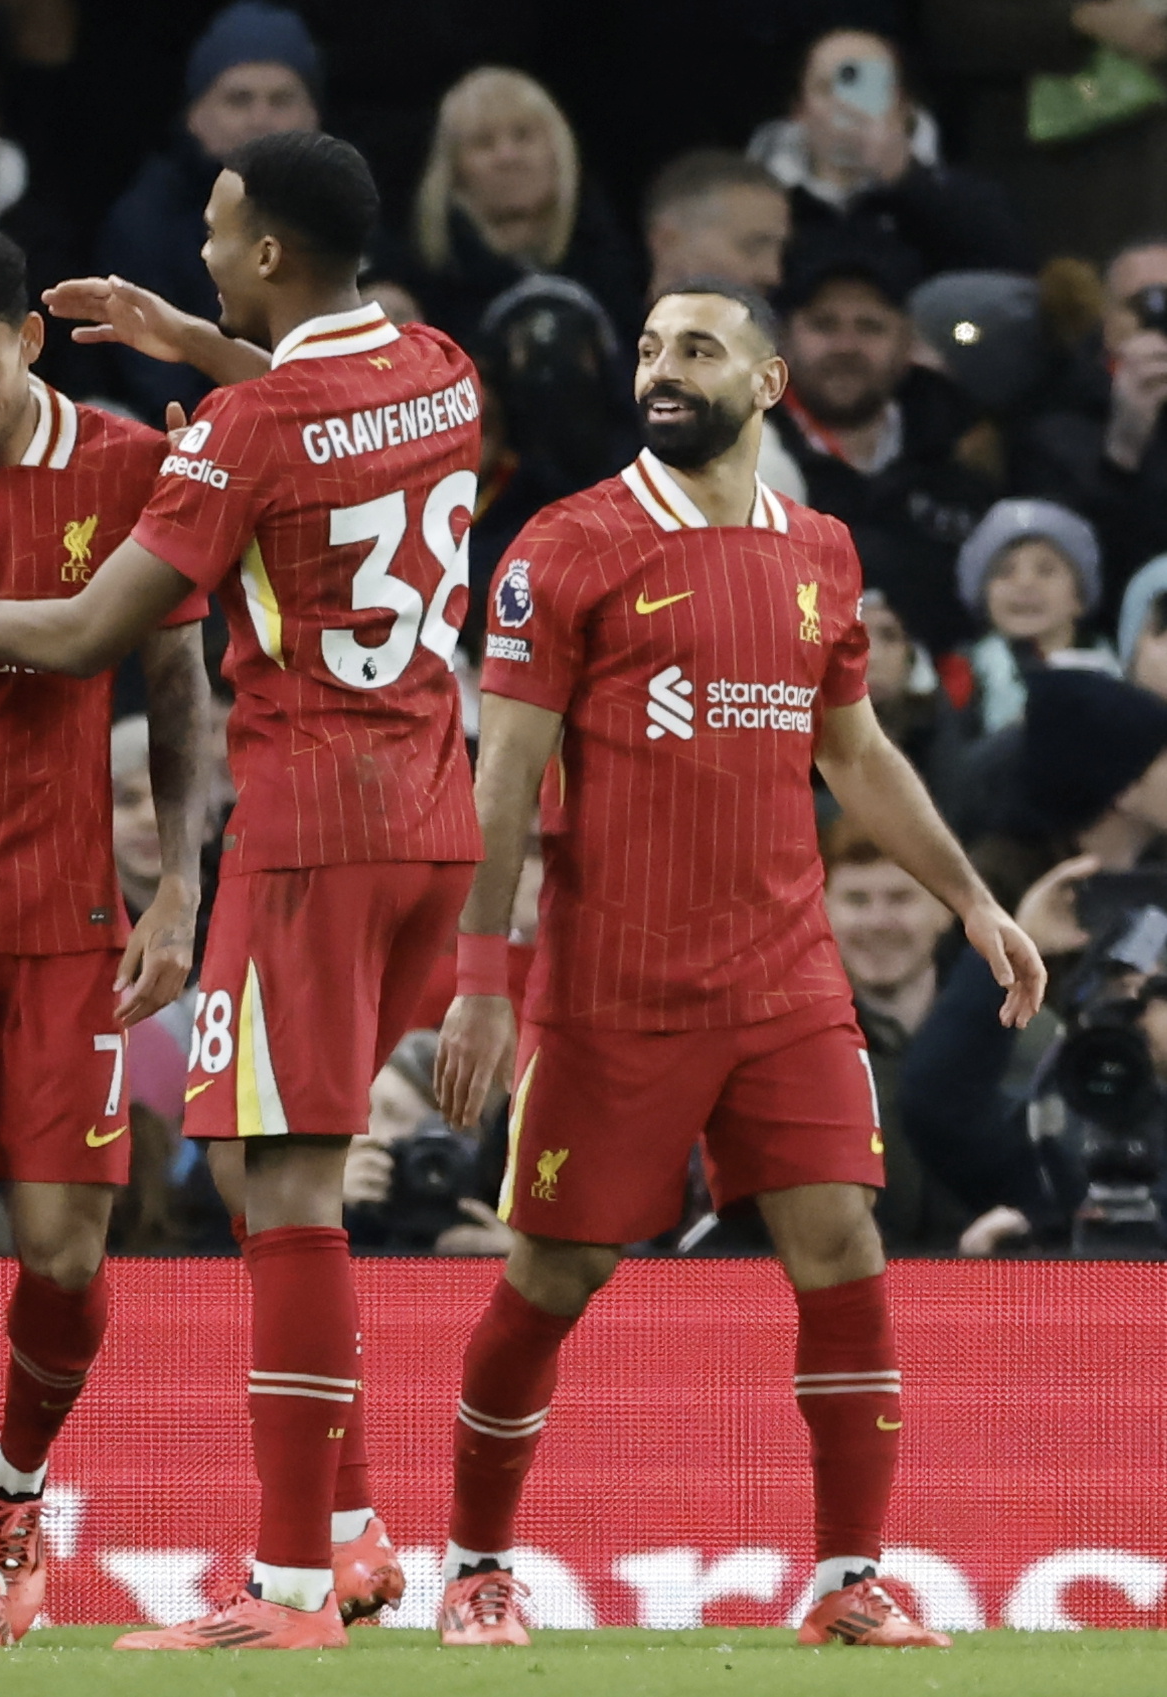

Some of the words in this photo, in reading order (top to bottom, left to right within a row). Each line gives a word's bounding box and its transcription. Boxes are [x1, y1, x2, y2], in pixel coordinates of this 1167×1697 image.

[302, 376, 479, 465] GRAVENBERCH
[159, 455, 229, 490] pedia
[61, 566, 92, 582] LFC
[321, 469, 478, 689] 38
[800, 626, 822, 645] LFC
[706, 678, 817, 708] standard
[707, 704, 812, 733] chartered
[94, 1033, 123, 1117] 7
